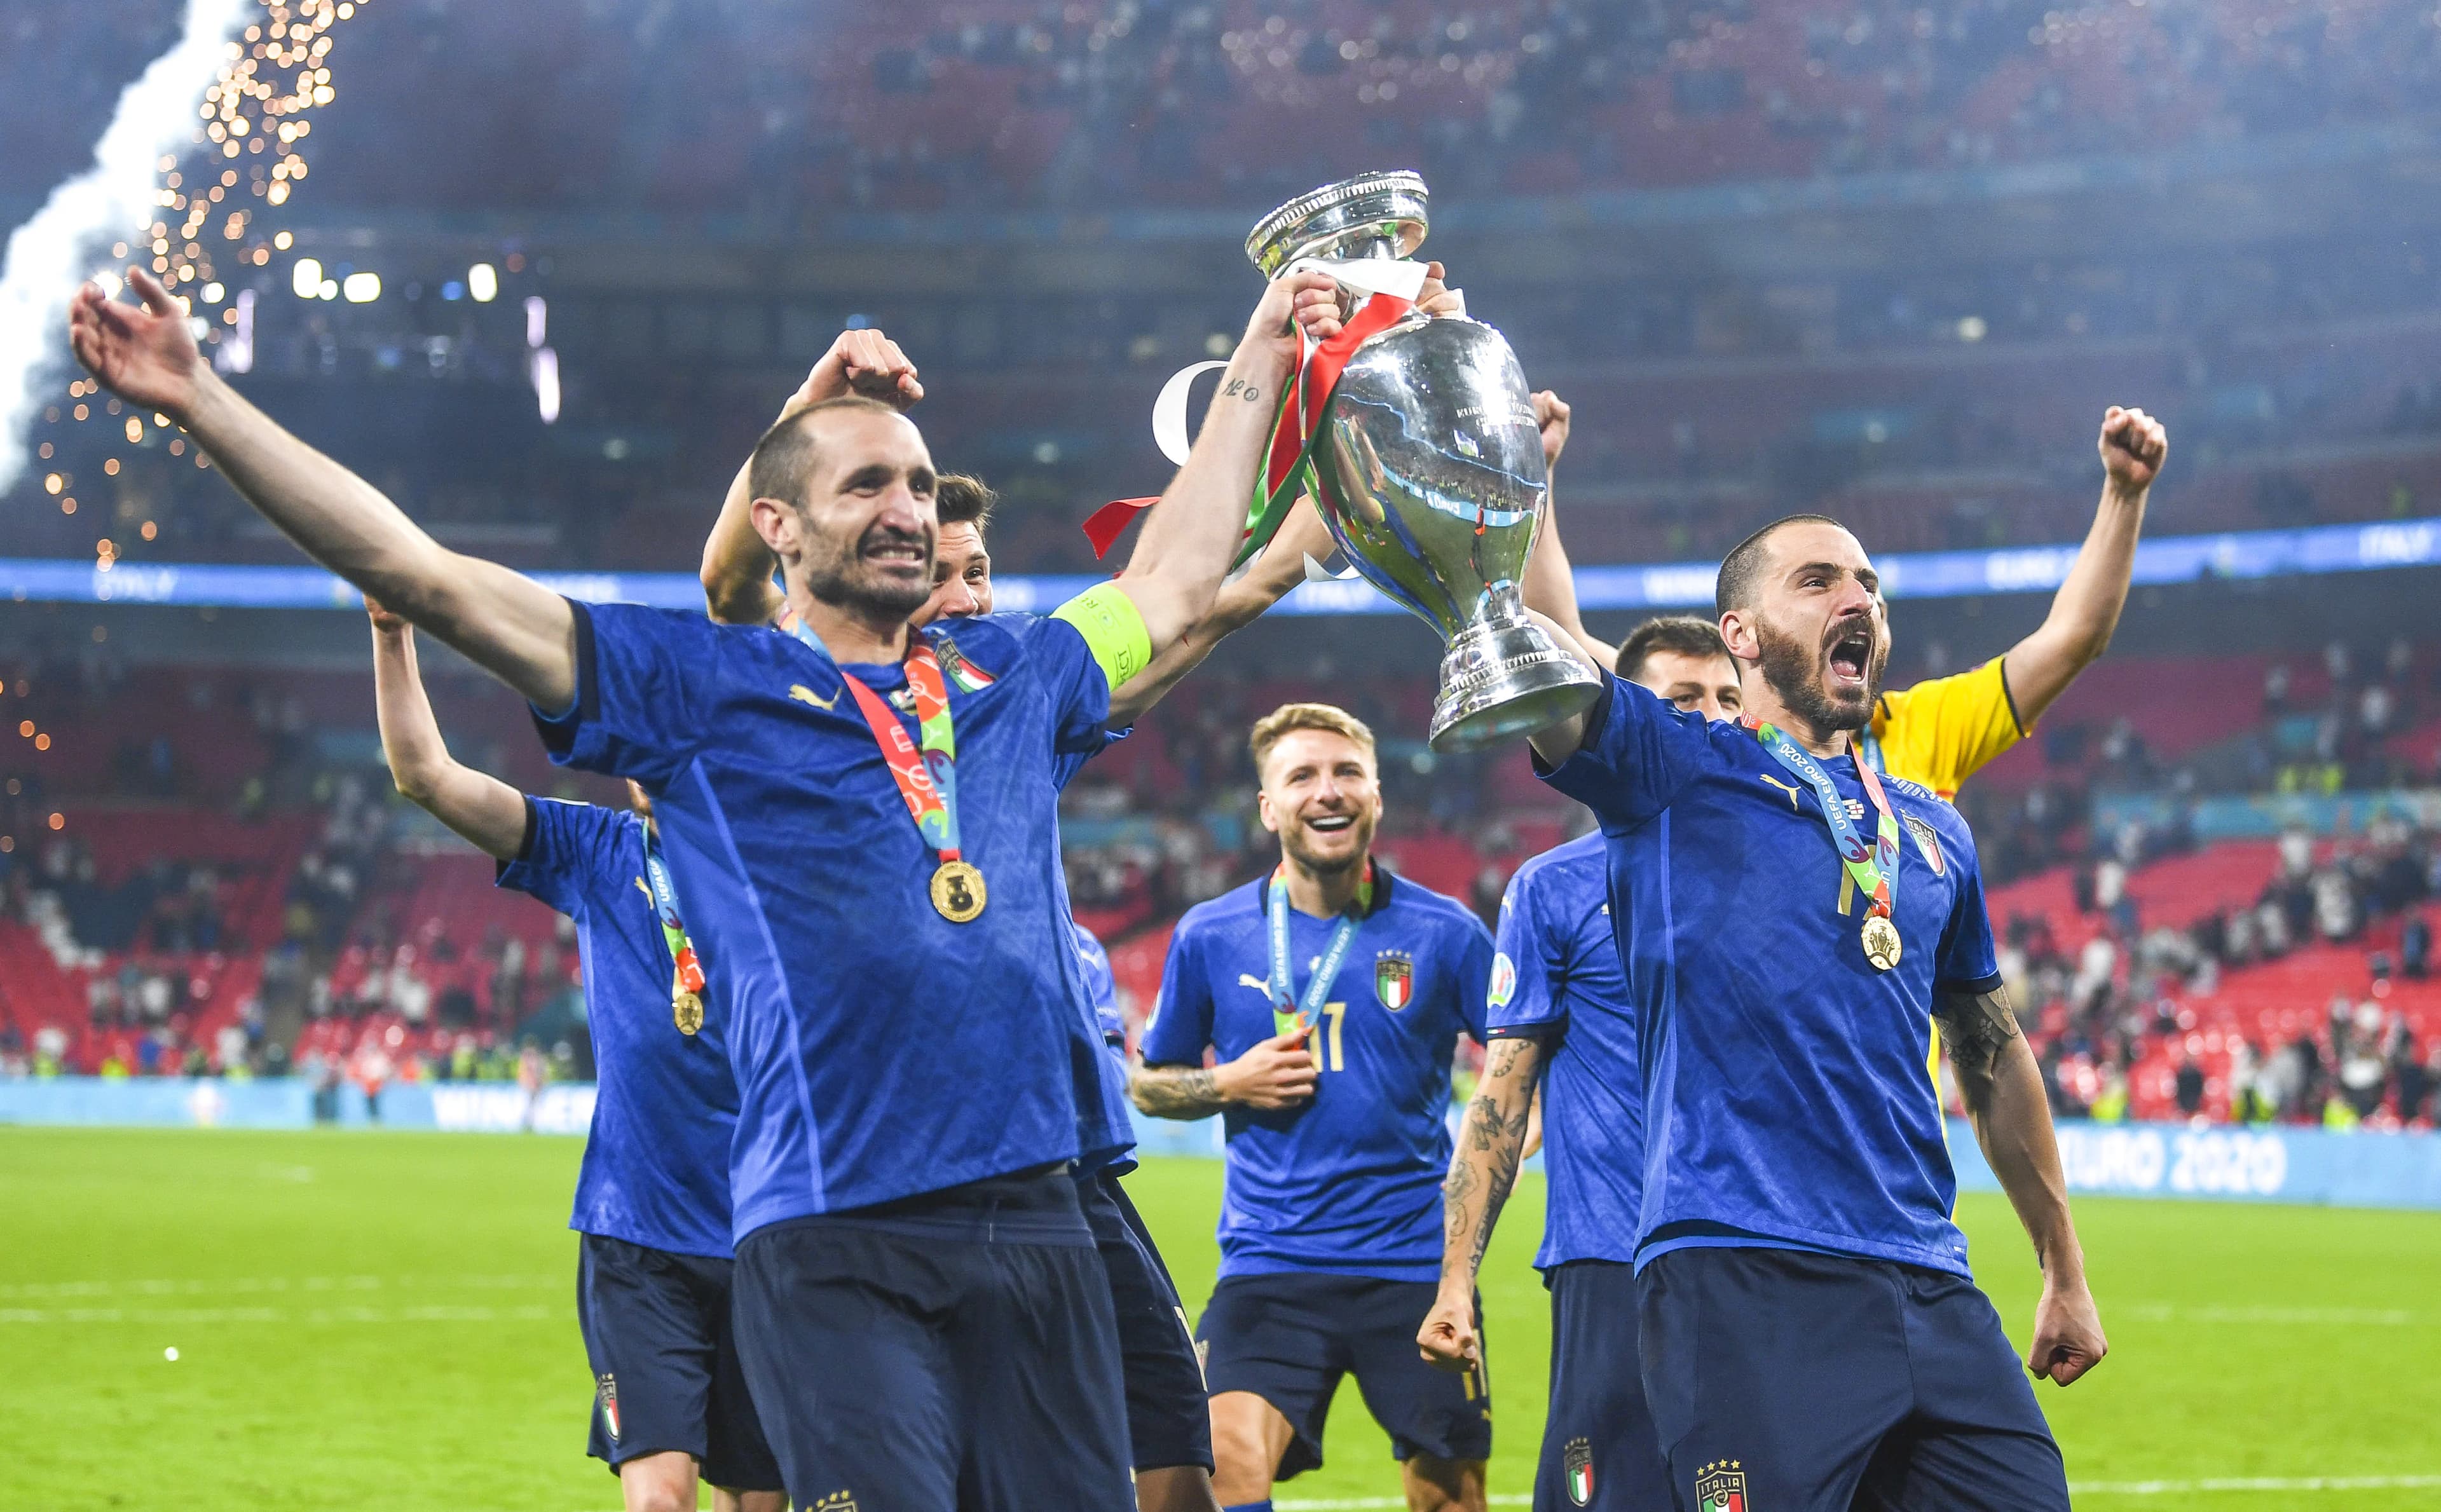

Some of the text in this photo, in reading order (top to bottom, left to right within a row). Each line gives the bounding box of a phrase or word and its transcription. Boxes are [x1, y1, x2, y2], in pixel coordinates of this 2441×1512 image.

[1779, 742, 1847, 830] UEFA EURO 2020
[1309, 1002, 1346, 1073] 17
[2168, 1131, 2287, 1195] 2020
[1701, 1478, 1740, 1495] ITALIA
